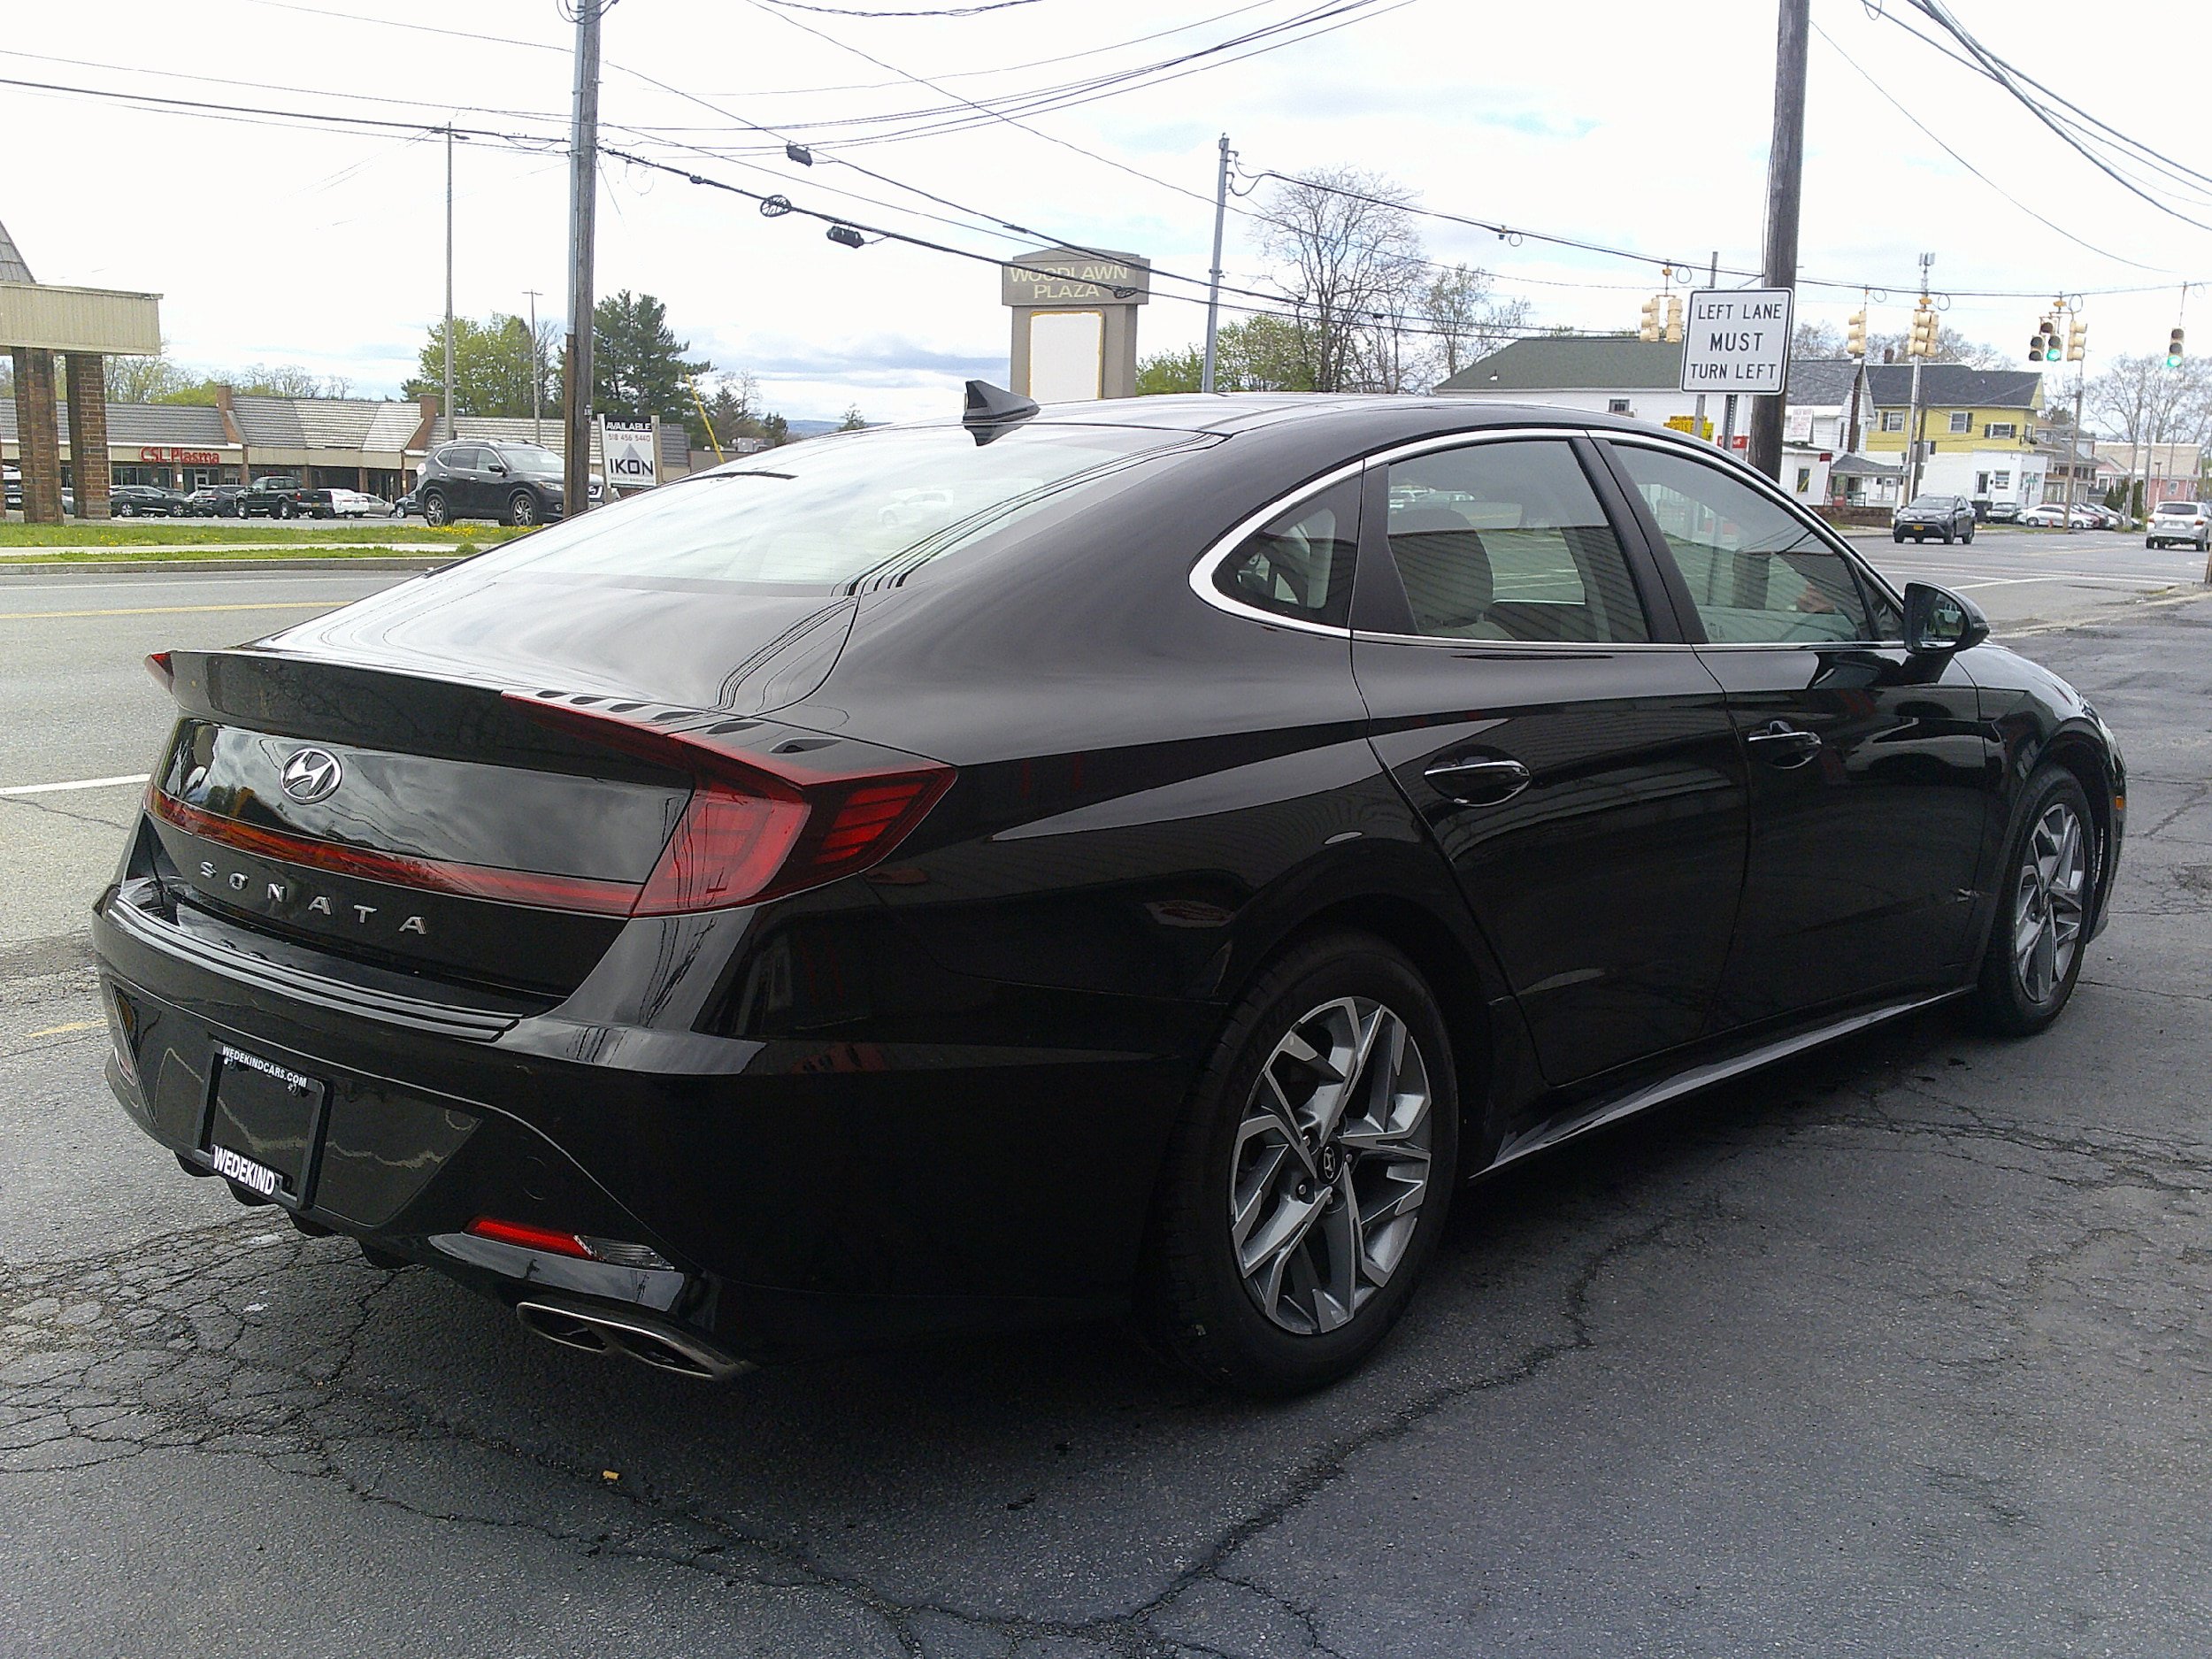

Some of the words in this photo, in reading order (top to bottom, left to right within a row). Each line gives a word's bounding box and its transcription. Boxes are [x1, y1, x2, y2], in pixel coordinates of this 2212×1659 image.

[1010, 265, 1129, 282] WOODLAWN
[1033, 284, 1100, 299] PLAZA
[1698, 304, 1734, 319] LEFT
[1742, 303, 1782, 319] LANE
[1709, 333, 1764, 352] MUST
[1691, 363, 1728, 380] TURN
[1735, 364, 1777, 380] LEFT
[606, 421, 652, 431] AVAILABLE
[140, 446, 170, 463] CSL
[170, 448, 220, 465] Plasma
[609, 457, 654, 476] IKON
[200, 860, 429, 935] SONATA
[222, 1045, 307, 1088] WEDEKINDCARS.COM
[212, 1145, 276, 1195] WEDEKIND
